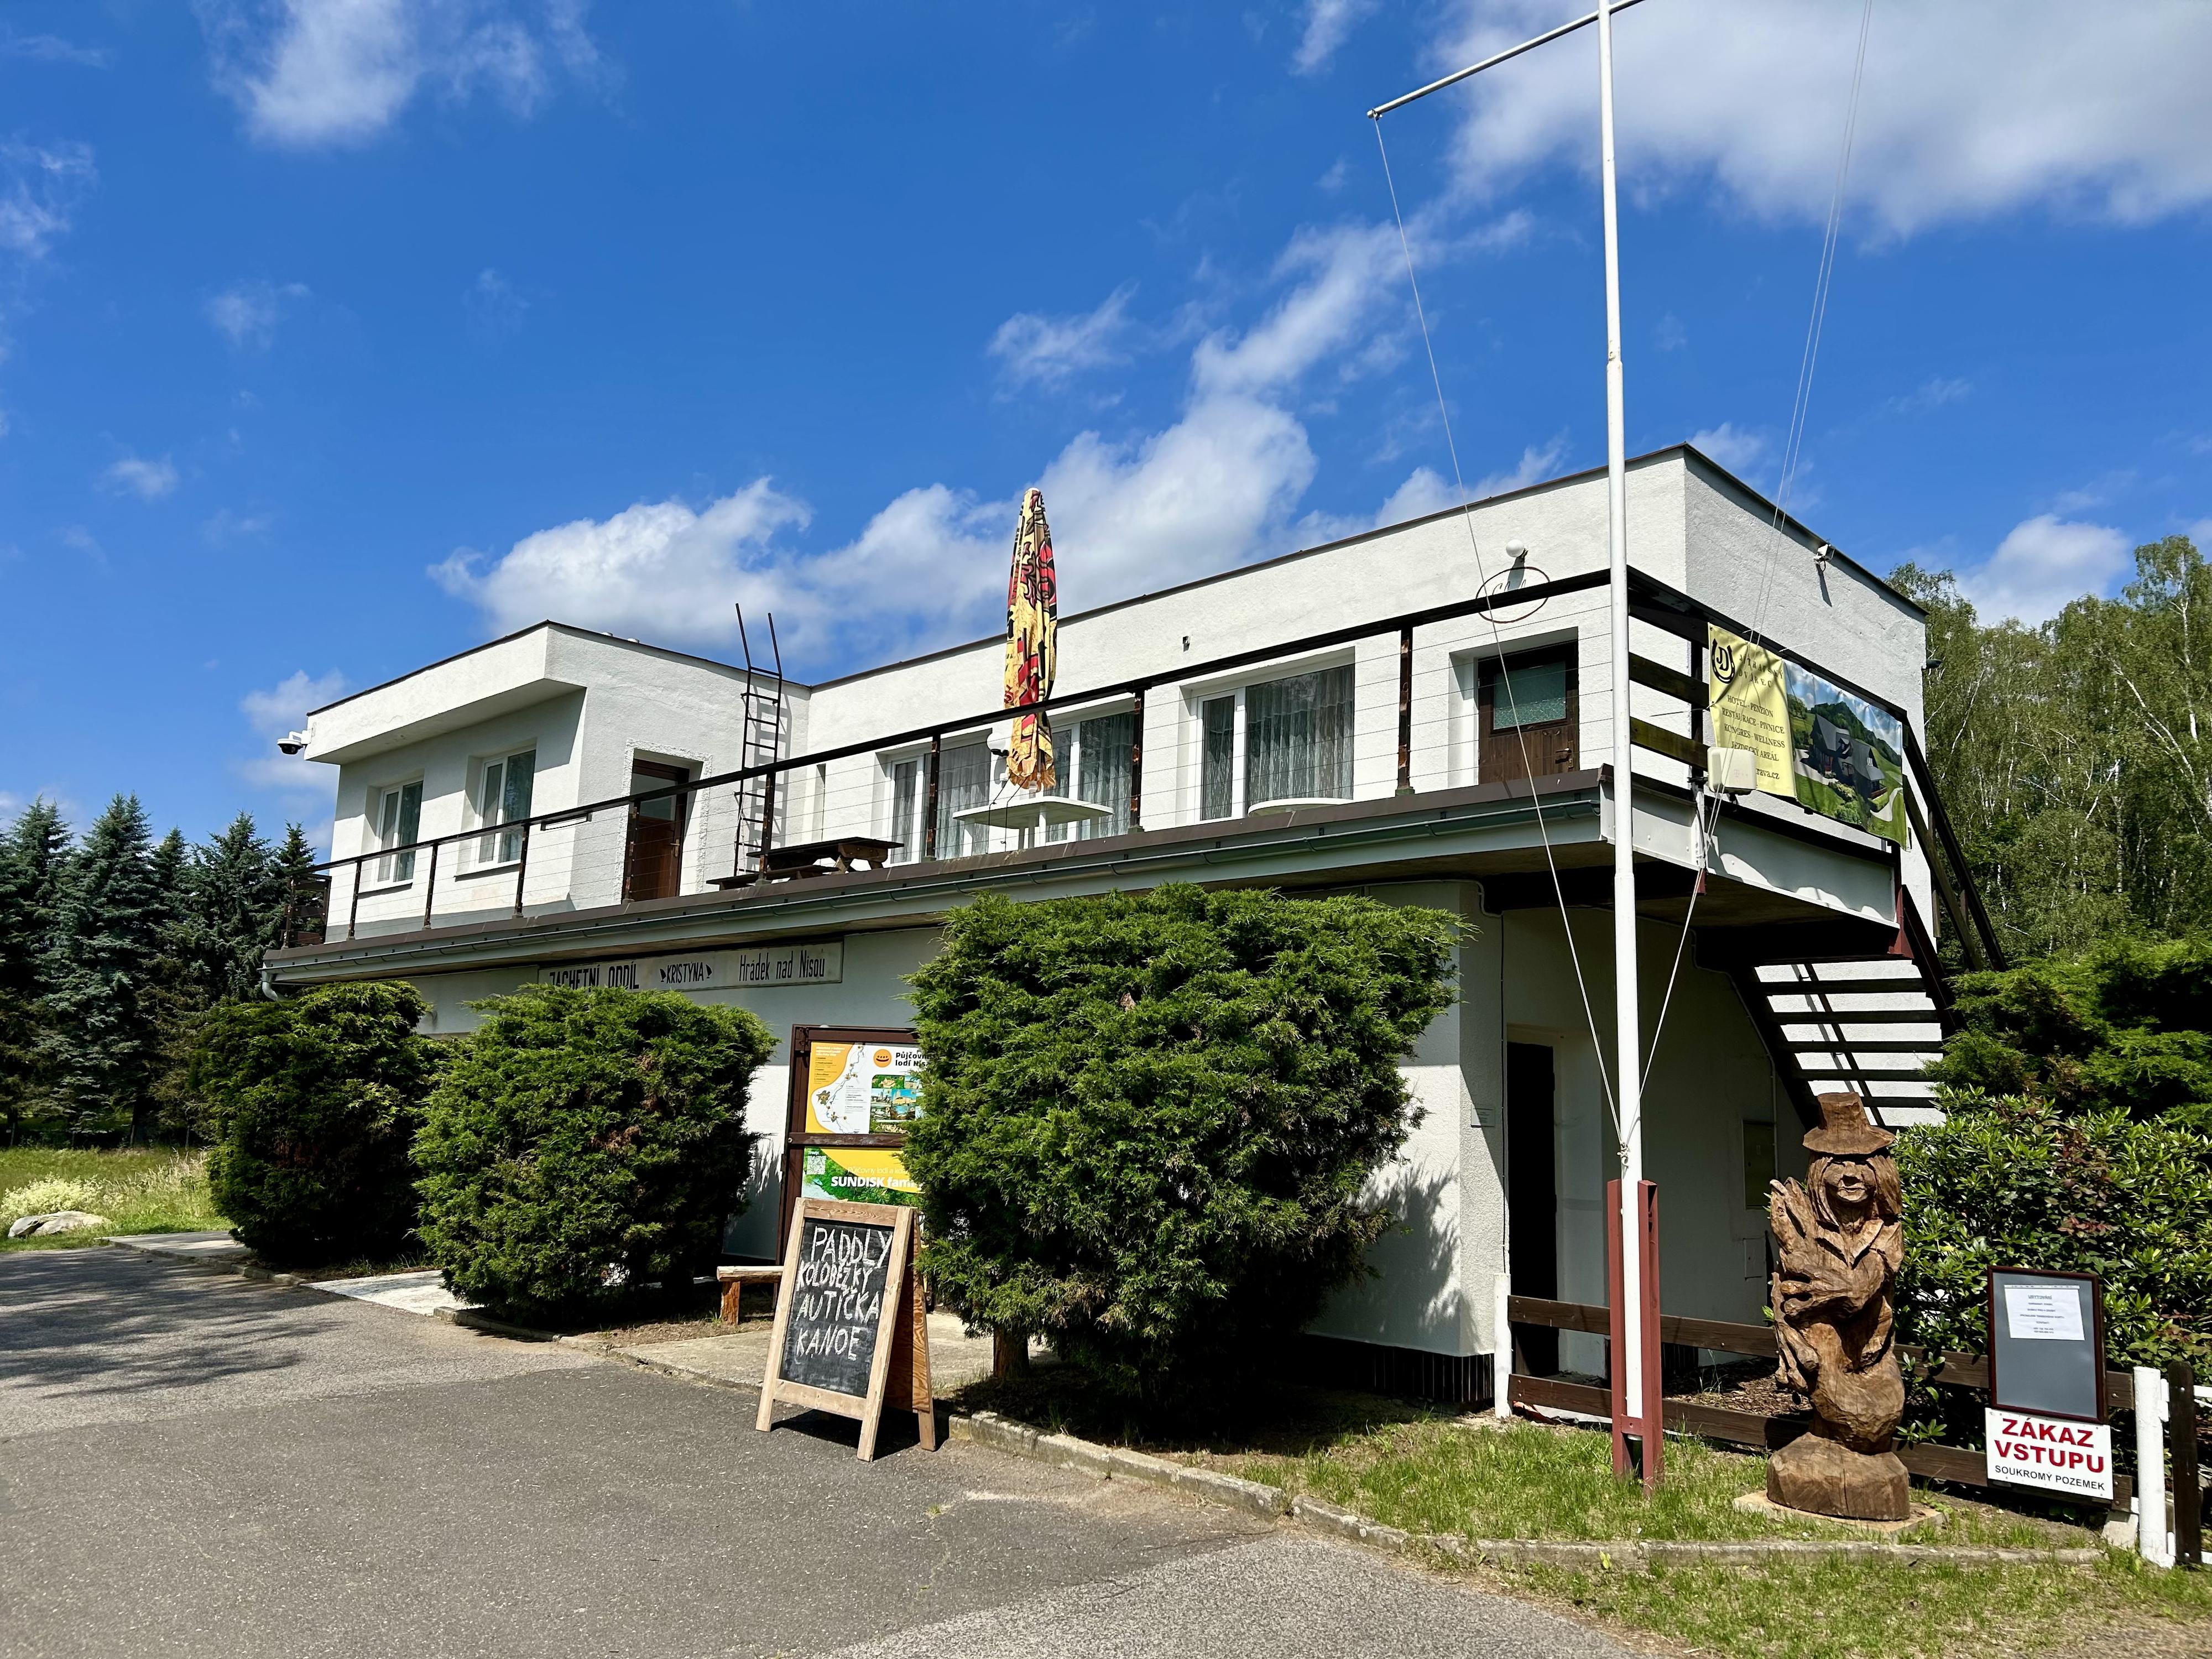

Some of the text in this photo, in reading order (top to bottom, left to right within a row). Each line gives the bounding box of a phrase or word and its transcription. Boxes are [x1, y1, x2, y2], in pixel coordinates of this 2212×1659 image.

[1754, 733, 1786, 748] WELLNESS
[608, 961, 640, 990] ODDÍL
[666, 961, 705, 984] KRISTÝNA
[739, 952, 770, 982] Hrádek
[776, 950, 794, 979] nad
[799, 950, 826, 978] Nisou
[831, 1176, 885, 1187] SUNDISK
[810, 1225, 893, 1269] PADDLY
[796, 1324, 862, 1361] KANOE
[2002, 1417, 2095, 1448] ZÁKAZ
[1994, 1440, 2105, 1473] VSTUPU
[2056, 1475, 2105, 1491] POZEMEK
